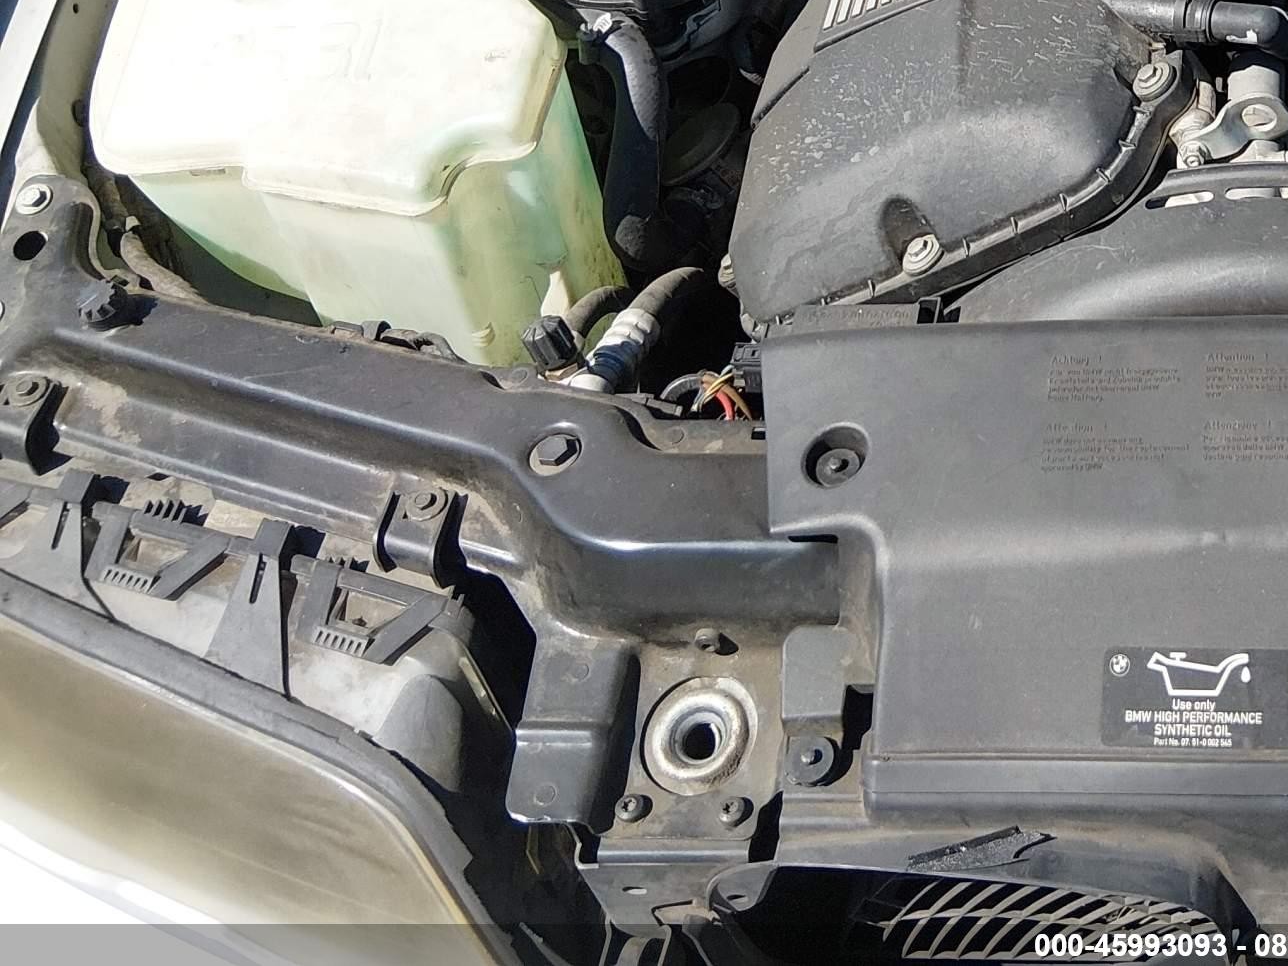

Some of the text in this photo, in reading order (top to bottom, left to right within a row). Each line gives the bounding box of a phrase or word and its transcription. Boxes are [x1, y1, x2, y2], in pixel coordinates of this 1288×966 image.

[1172, 698, 1216, 711] Use only
[1125, 710, 1263, 724] BMW HIGH PERFORMANCE
[1154, 724, 1232, 736] SYNTHETIC OIL
[1153, 737, 1168, 746] Part
